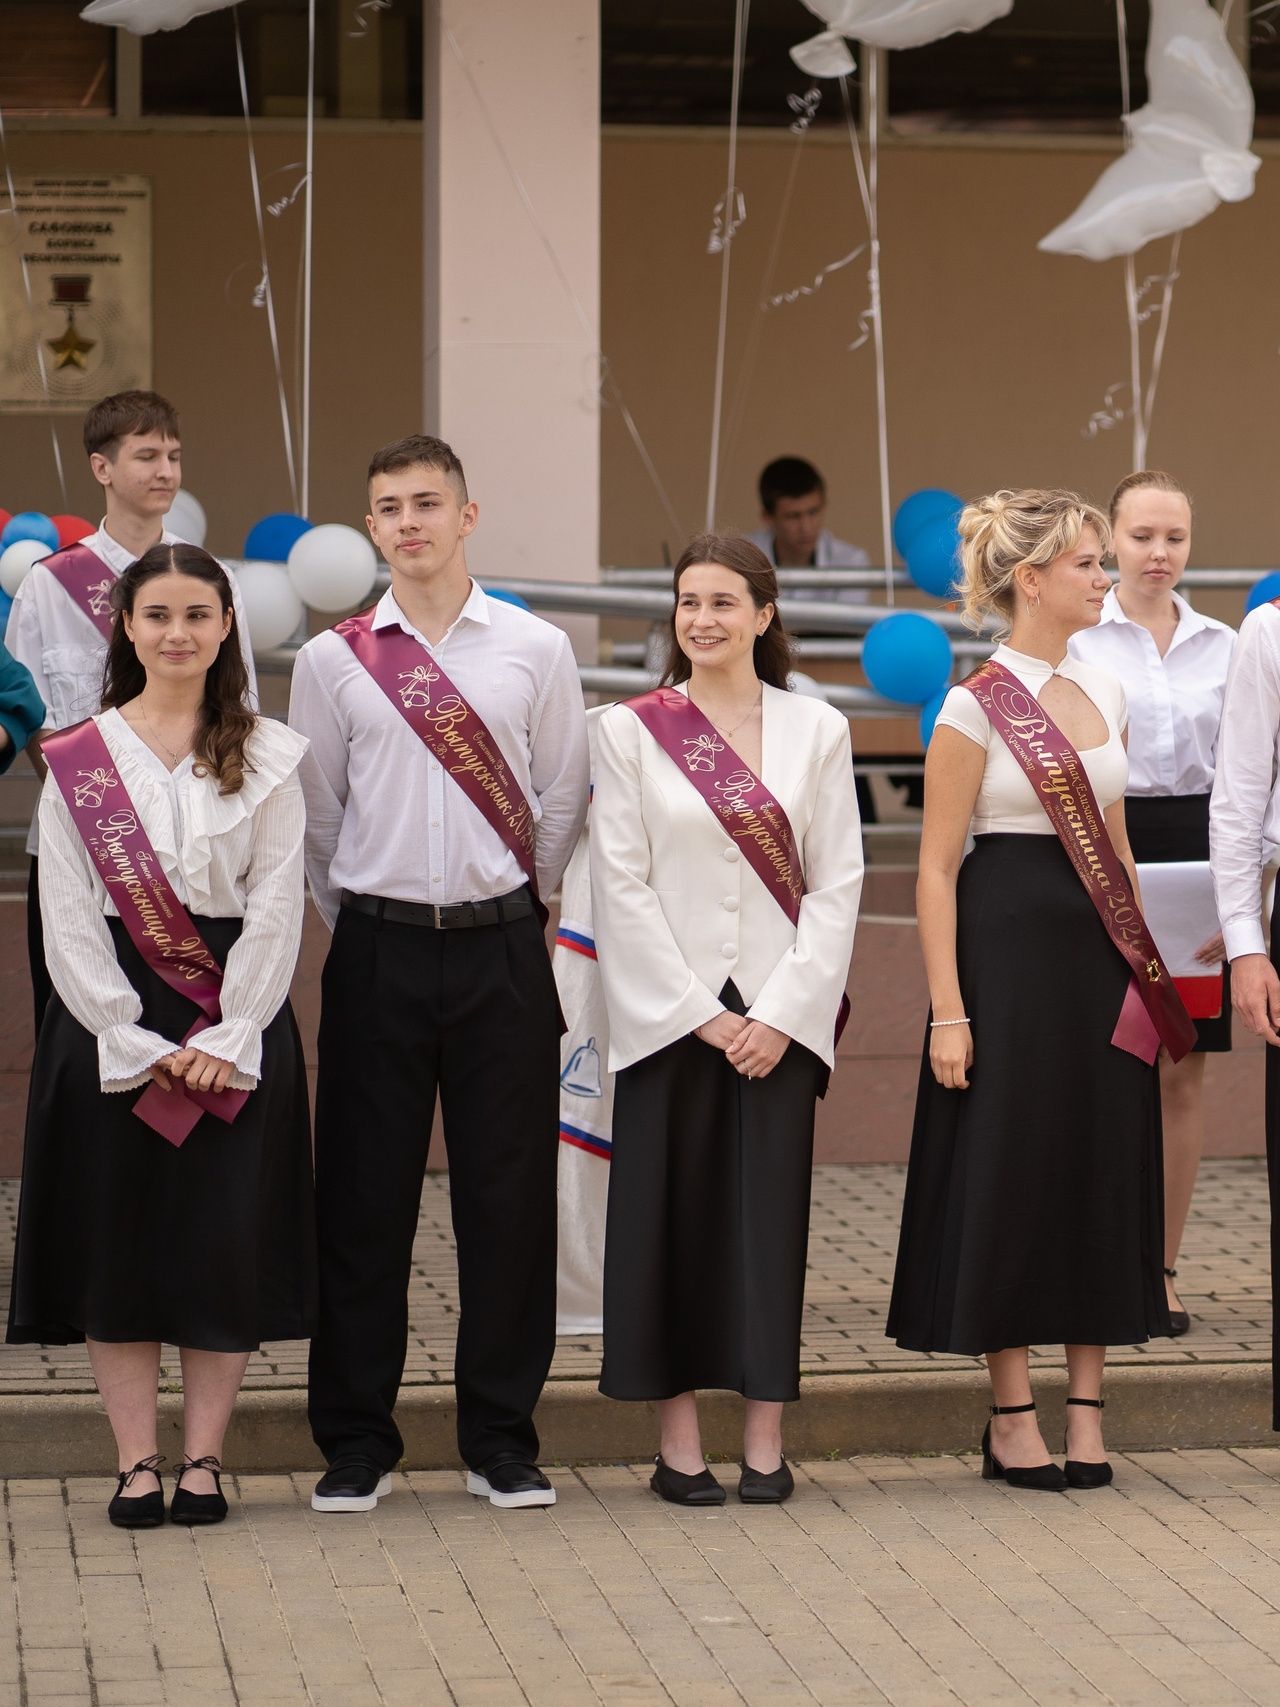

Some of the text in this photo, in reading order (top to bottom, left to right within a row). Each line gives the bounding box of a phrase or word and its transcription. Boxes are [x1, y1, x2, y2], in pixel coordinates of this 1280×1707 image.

[425, 694, 512, 815] Выпускник
[1059, 750, 1101, 840] Шпак Елизавета
[96, 809, 172, 946] Выпускница
[136, 850, 153, 880] Гапон
[714, 770, 794, 889] Выпускница
[991, 682, 1150, 954] Выпускница 2026
